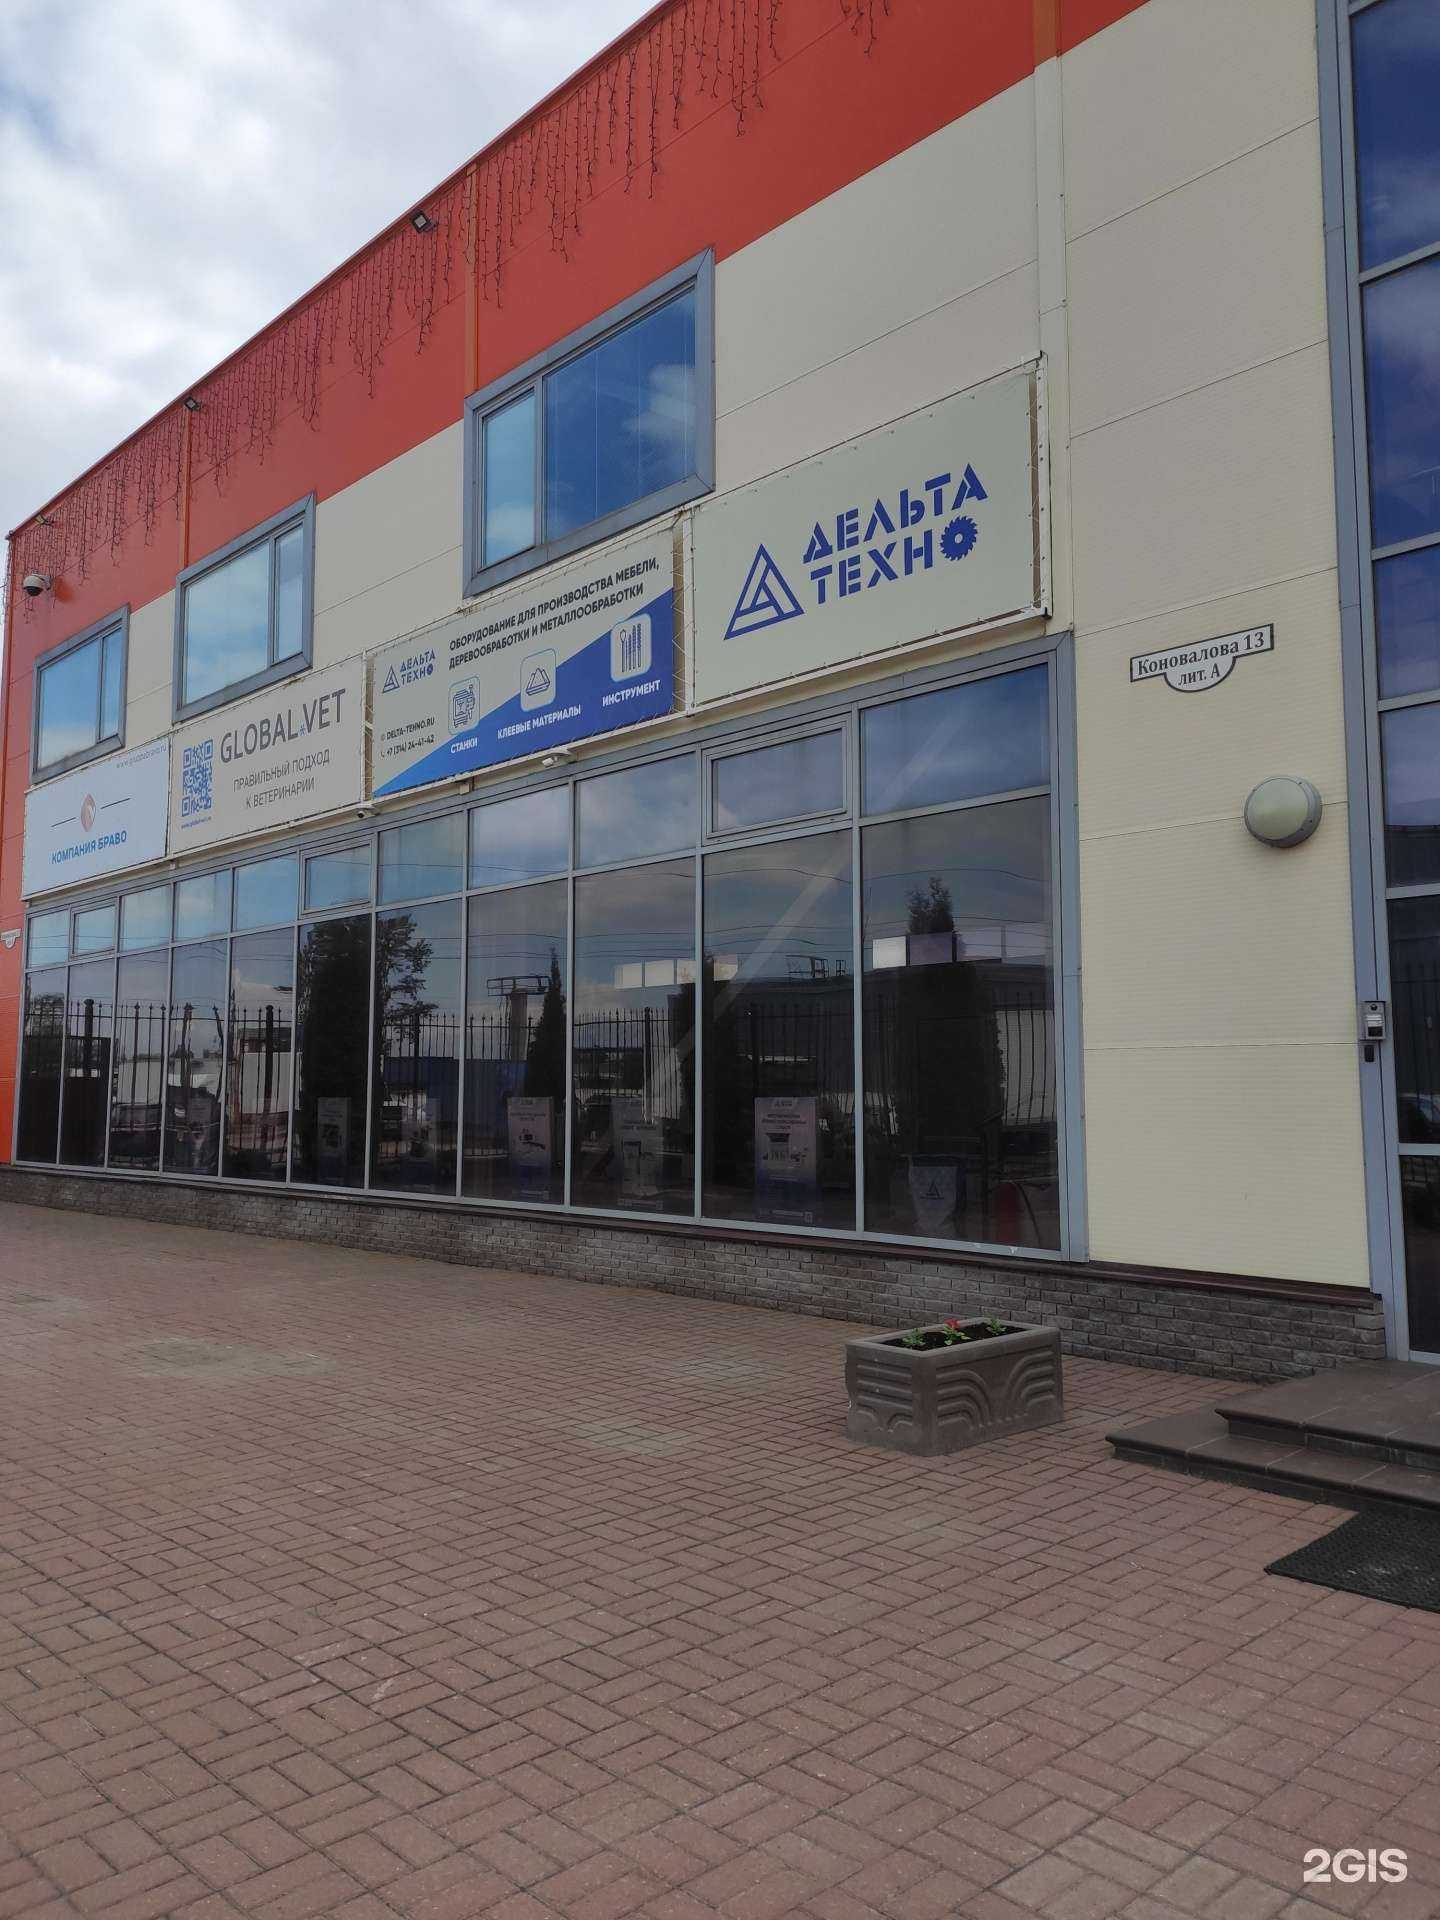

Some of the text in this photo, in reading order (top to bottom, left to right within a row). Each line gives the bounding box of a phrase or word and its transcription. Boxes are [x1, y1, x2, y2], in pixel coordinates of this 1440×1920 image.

[803, 463, 988, 564] ДЕЛЬТА
[810, 515, 977, 604] ТЕХНО
[450, 557, 659, 651] ОБОРУДОВАНИЕ ДЛЯ ПРОИЗВОДСТВА МЕБЕЛИ,
[449, 584, 643, 670] ДЕРЕВООБРАБОТКИ И МЕТАЛЛООБРАБОТКИ
[400, 649, 436, 672] ДЕЛЬТА
[1138, 632, 1264, 675] Коновалова 13
[1178, 663, 1220, 686] лит. А
[602, 679, 660, 707] ИНСТРУМЕНТ
[497, 705, 581, 739] КЛЕЕВЫЕ МАТЕРИАЛЫ
[451, 737, 477, 754] СТАНКИ
[233, 751, 330, 792] ПРАВИЛЬНЫЙ ПОДХОД
[246, 778, 315, 809] К ВЕТЕРИНАРИИ
[51, 830, 127, 864] КОМПАНИЯ БРАВО
